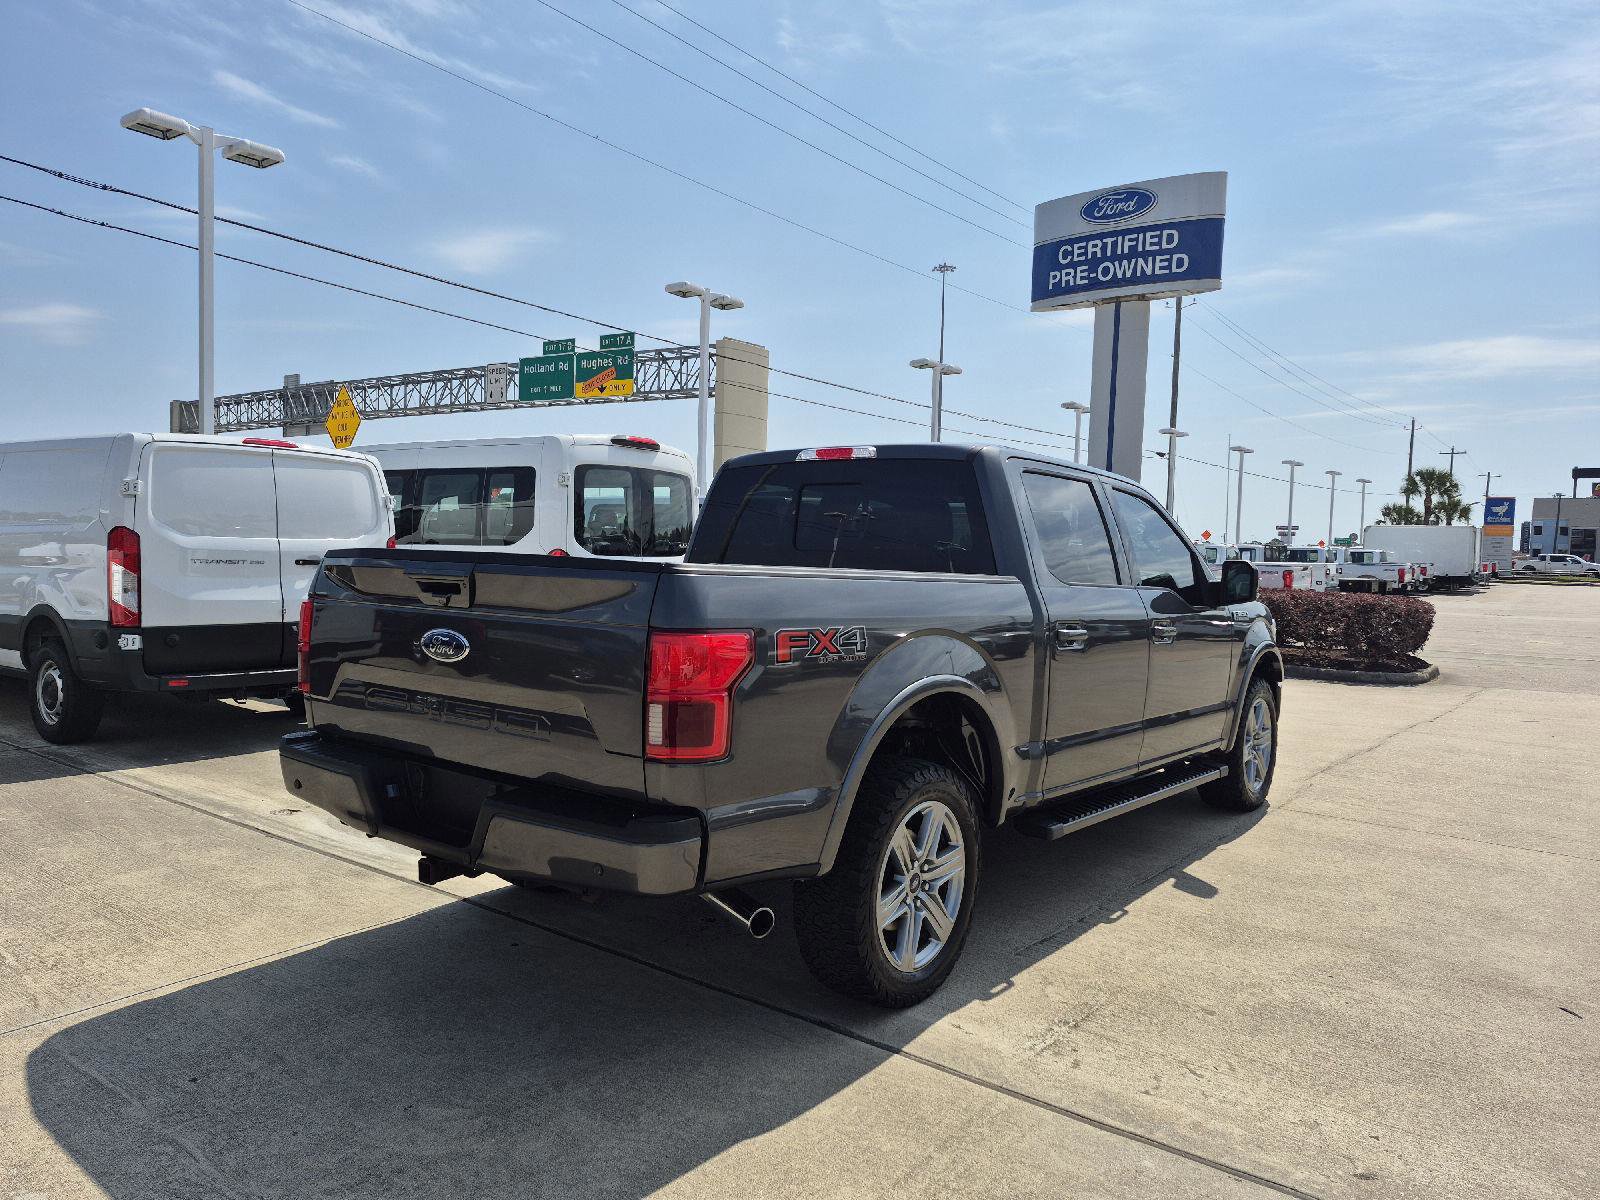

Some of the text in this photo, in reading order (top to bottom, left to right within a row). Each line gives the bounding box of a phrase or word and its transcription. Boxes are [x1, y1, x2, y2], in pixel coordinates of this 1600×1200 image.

[1094, 193, 1138, 217] Ford
[1058, 229, 1179, 265] CERTIFIED
[1048, 253, 1190, 290] PRE-OWNED
[524, 361, 569, 374] Holland Rd
[581, 354, 629, 370] Hughes Rd
[550, 385, 562, 393] MILE
[775, 626, 867, 666] FX4
